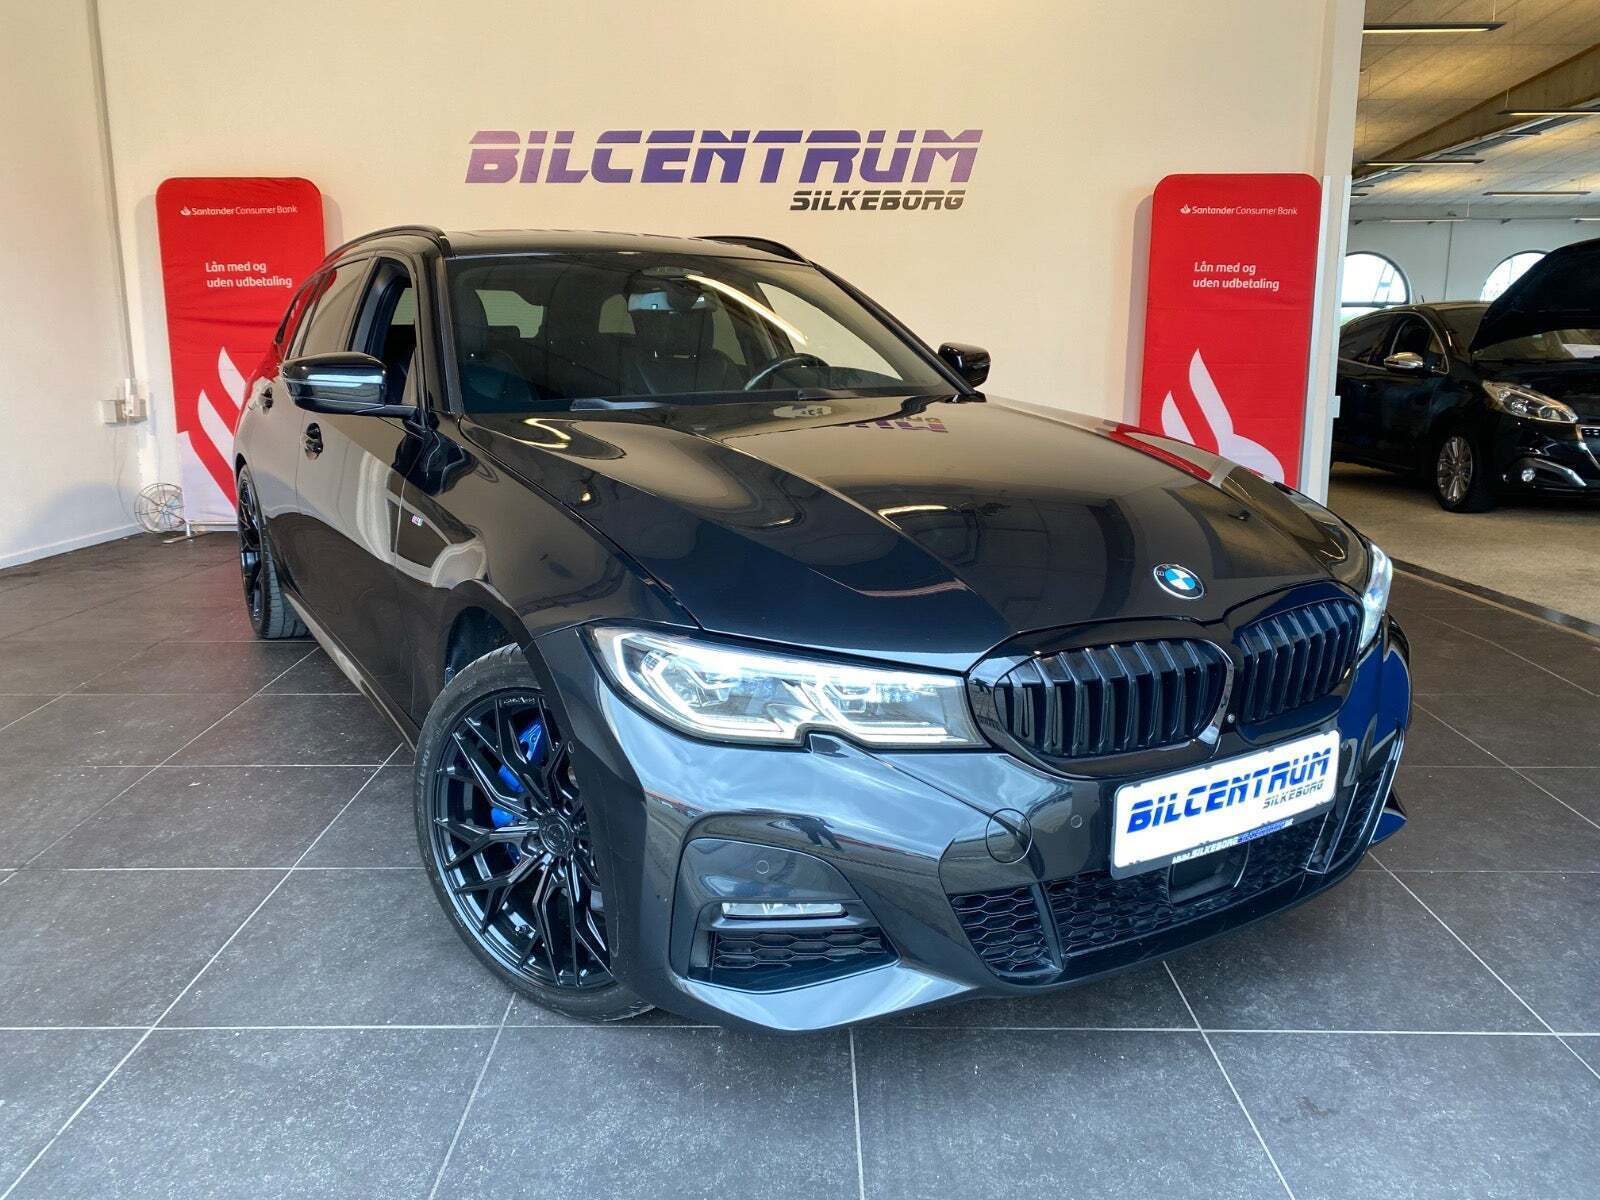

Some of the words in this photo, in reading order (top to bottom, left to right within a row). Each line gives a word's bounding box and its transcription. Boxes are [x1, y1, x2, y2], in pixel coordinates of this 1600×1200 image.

[464, 129, 984, 184] BILCENTRUM
[790, 190, 966, 211] SILKEBORG
[191, 206, 235, 216] Santander
[235, 205, 276, 215] Consumer
[276, 204, 298, 214] Bank
[1191, 205, 1235, 215] Santander
[1235, 206, 1277, 216] Consumer
[1277, 206, 1298, 216] Bank
[205, 260, 225, 273] Lån
[227, 261, 251, 272] med
[252, 263, 267, 274] og
[1193, 260, 1214, 273] Lån
[1215, 261, 1241, 273] med
[1242, 264, 1257, 276] og
[207, 277, 234, 288] uden
[235, 275, 293, 289] udbetaling
[1192, 277, 1220, 288] uden
[1222, 277, 1280, 292] udbetaling
[1126, 747, 1332, 834] BILCENTRUM
[1262, 779, 1325, 809] SILKEBORG
